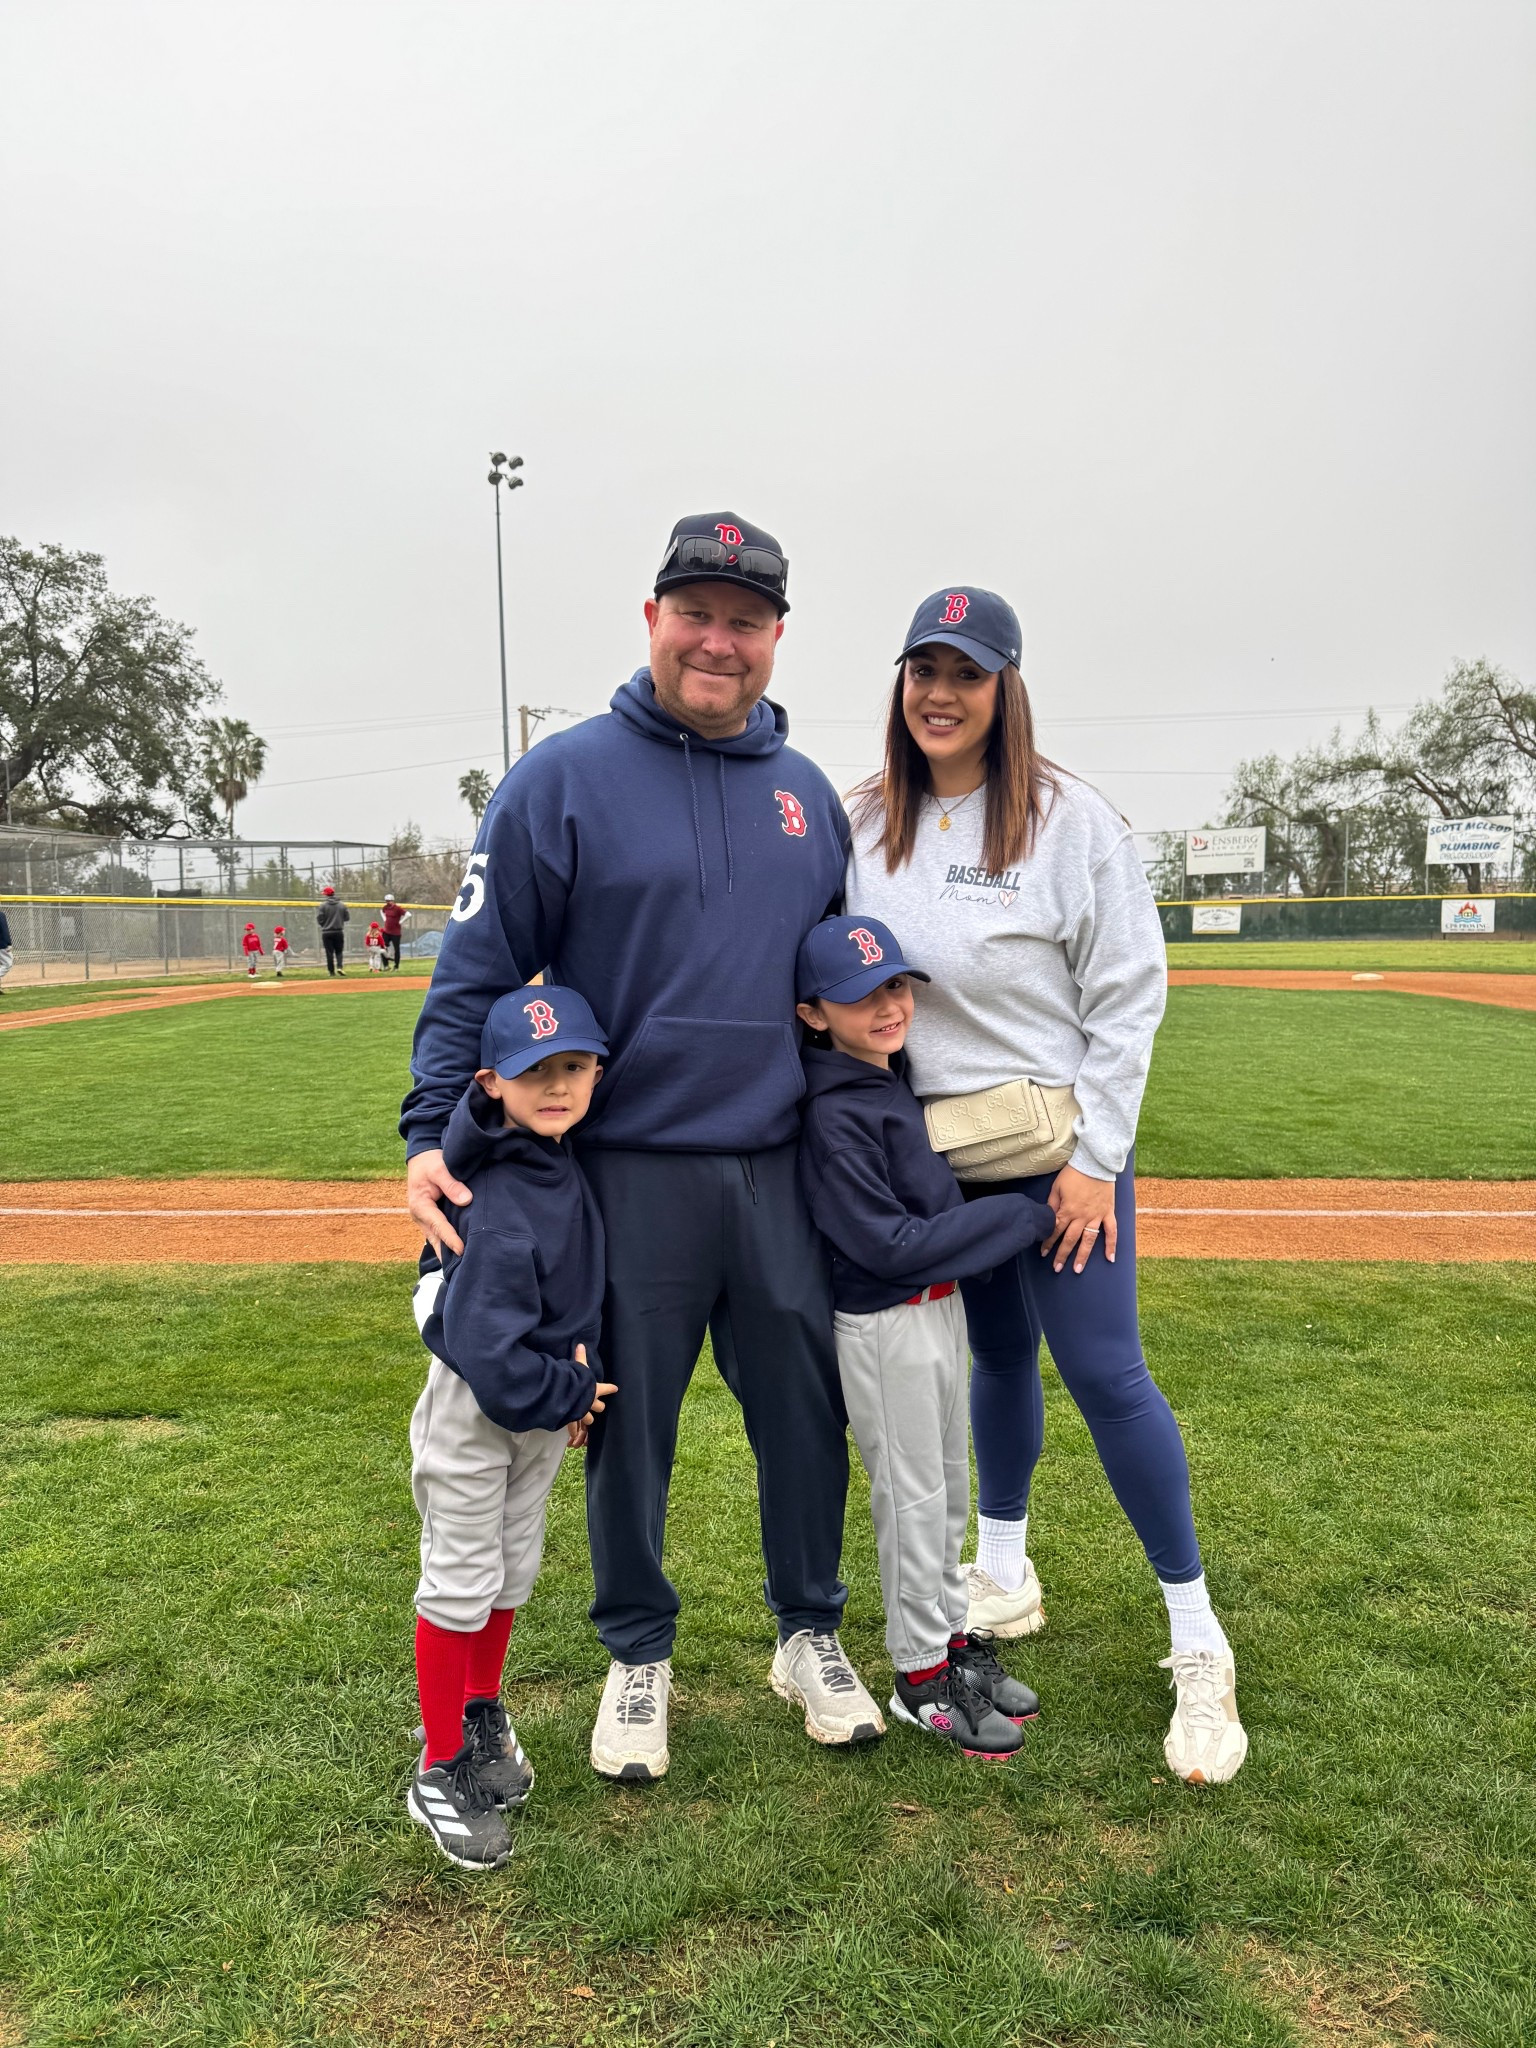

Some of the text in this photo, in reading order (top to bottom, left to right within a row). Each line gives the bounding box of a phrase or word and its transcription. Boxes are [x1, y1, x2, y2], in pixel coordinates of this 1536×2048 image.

[939, 594, 970, 624] B
[774, 790, 808, 837] B
[1212, 834, 1258, 846] ENSBERG
[1430, 821, 1513, 835] SCOTT MCLEOD
[1440, 842, 1500, 851] PLUMBING
[450, 853, 489, 922] 5
[945, 864, 1021, 891] BASEBALL
[939, 884, 997, 905] Mom
[848, 928, 883, 965] B
[523, 1000, 559, 1040] B
